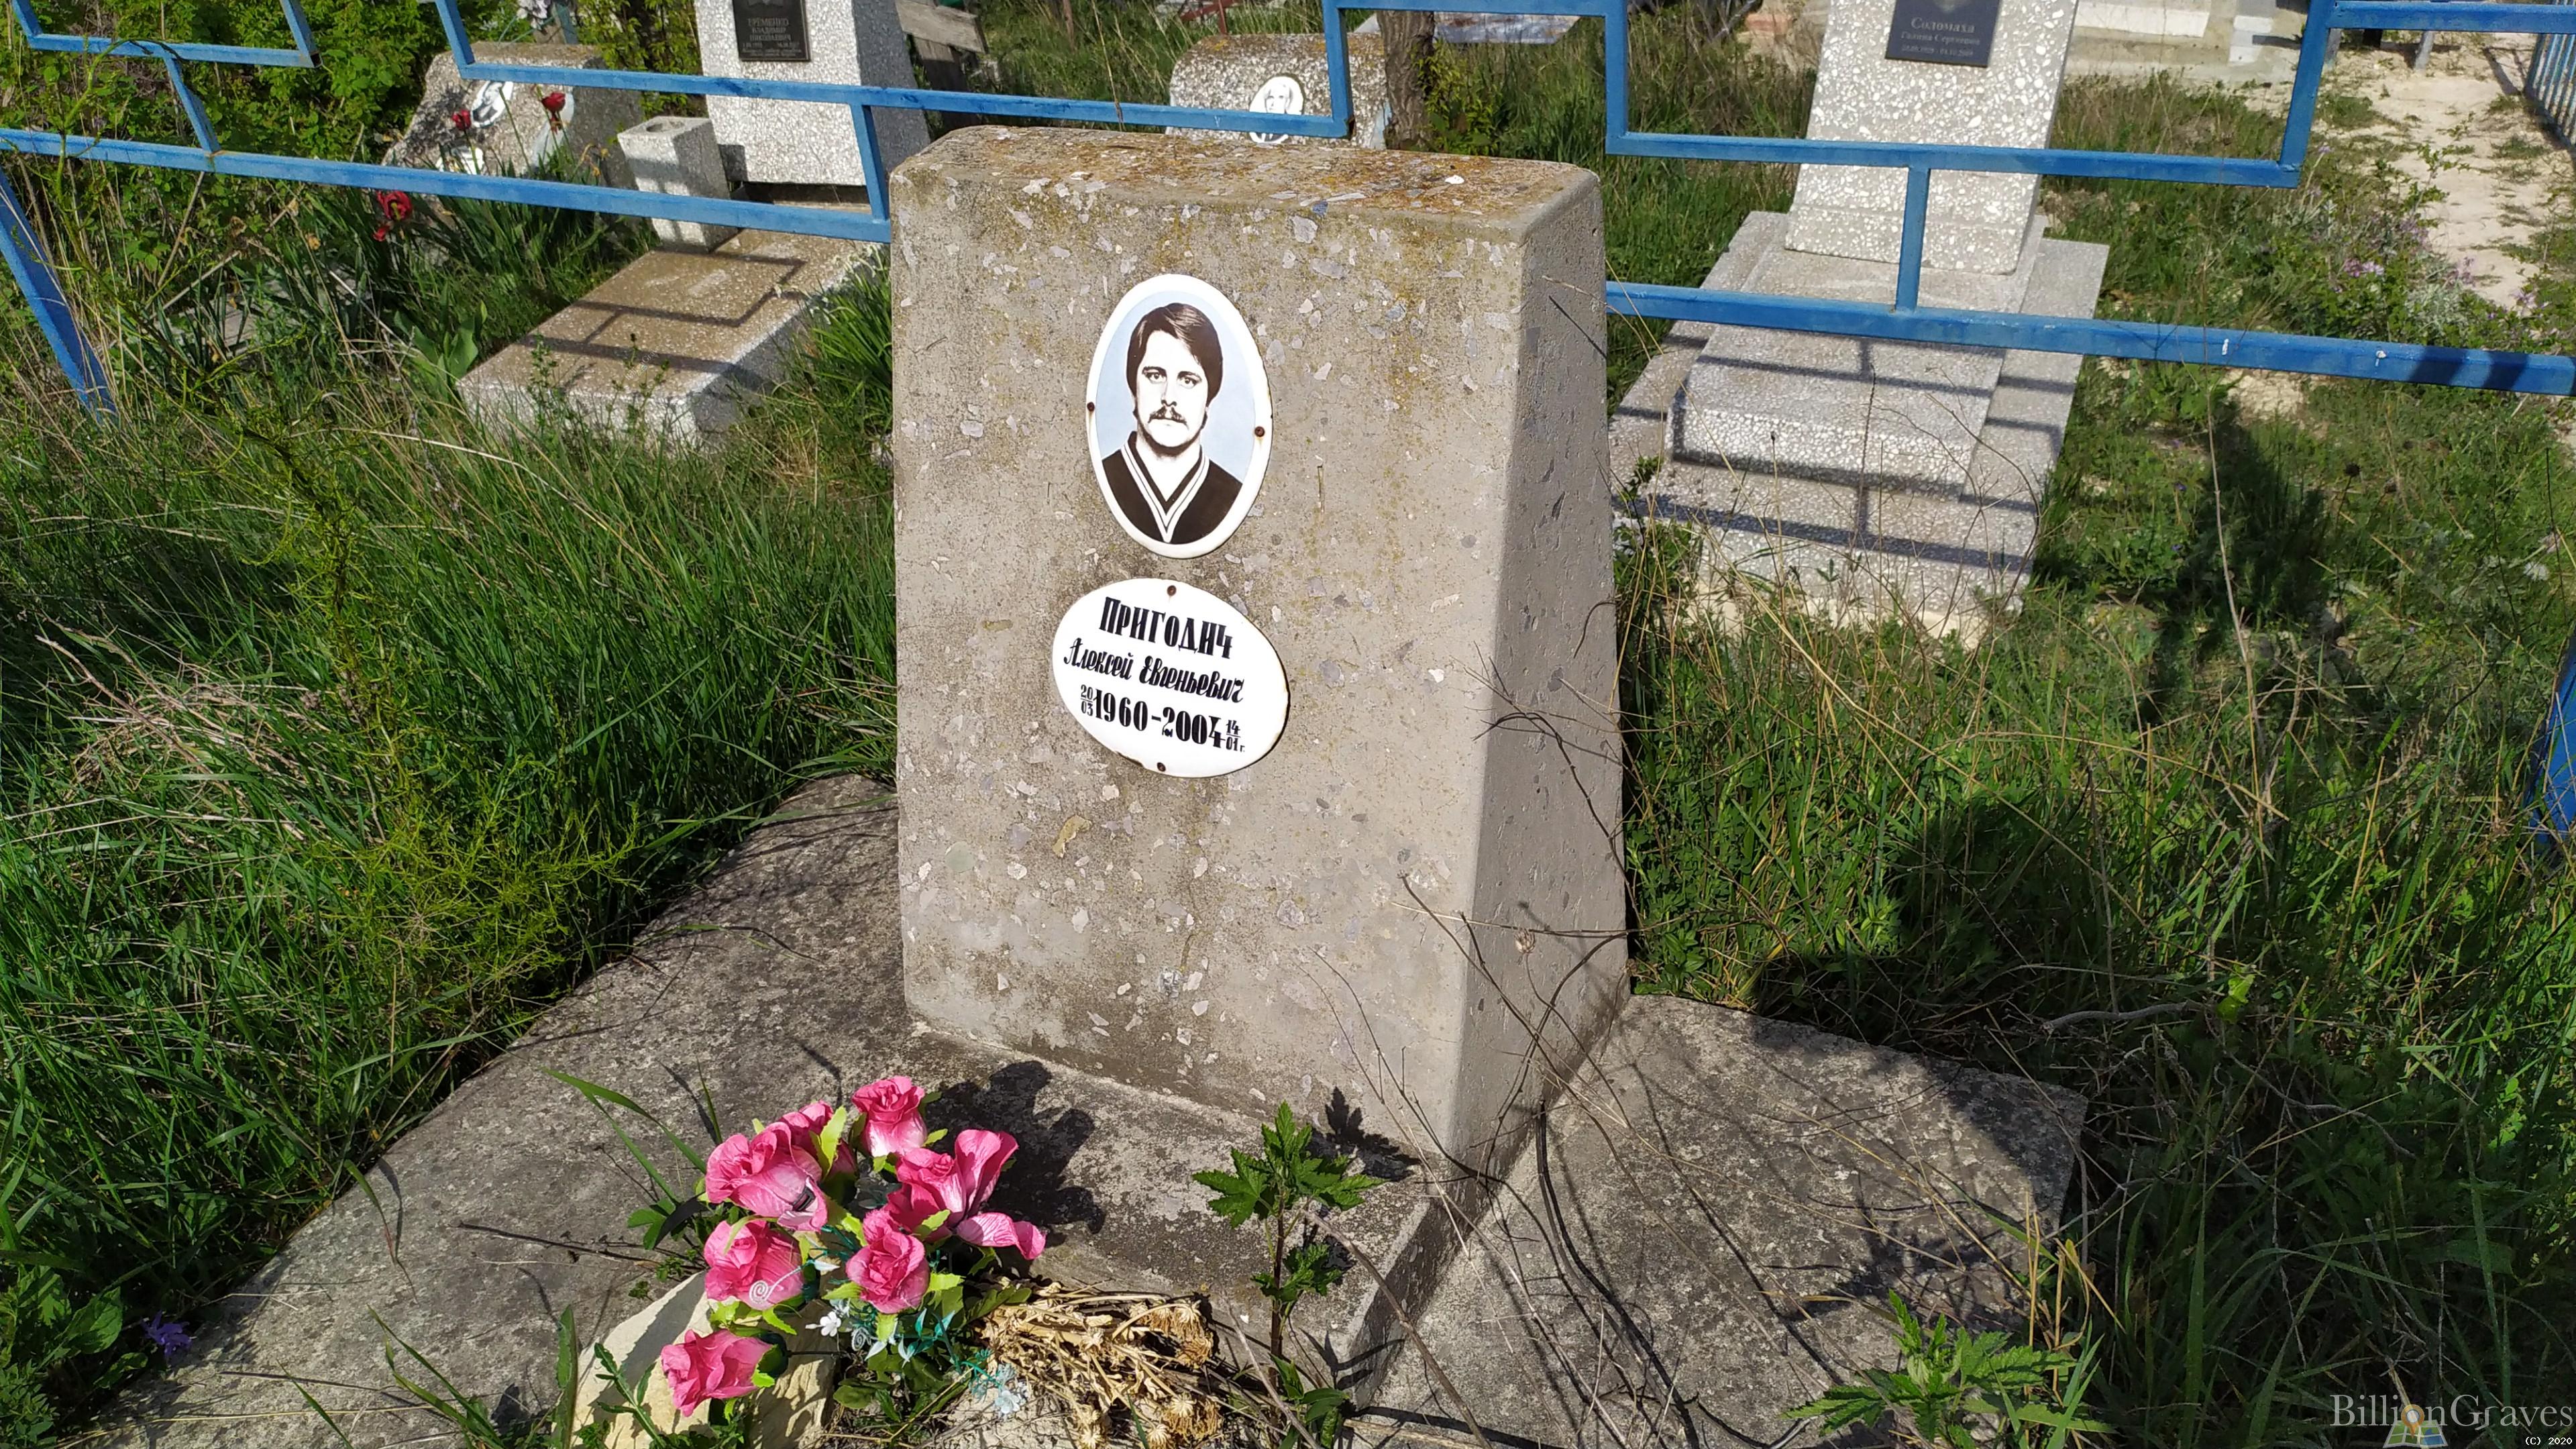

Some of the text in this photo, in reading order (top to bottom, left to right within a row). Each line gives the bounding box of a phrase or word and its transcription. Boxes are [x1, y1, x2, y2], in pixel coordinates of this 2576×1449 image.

[1099, 596, 1233, 659] ПРИГОДИЧ
[1063, 637, 1244, 703] Алексей Евгеньевич
[1081, 684, 1093, 699] 20
[1081, 700, 1093, 716] 03
[1226, 719, 1241, 735] 14
